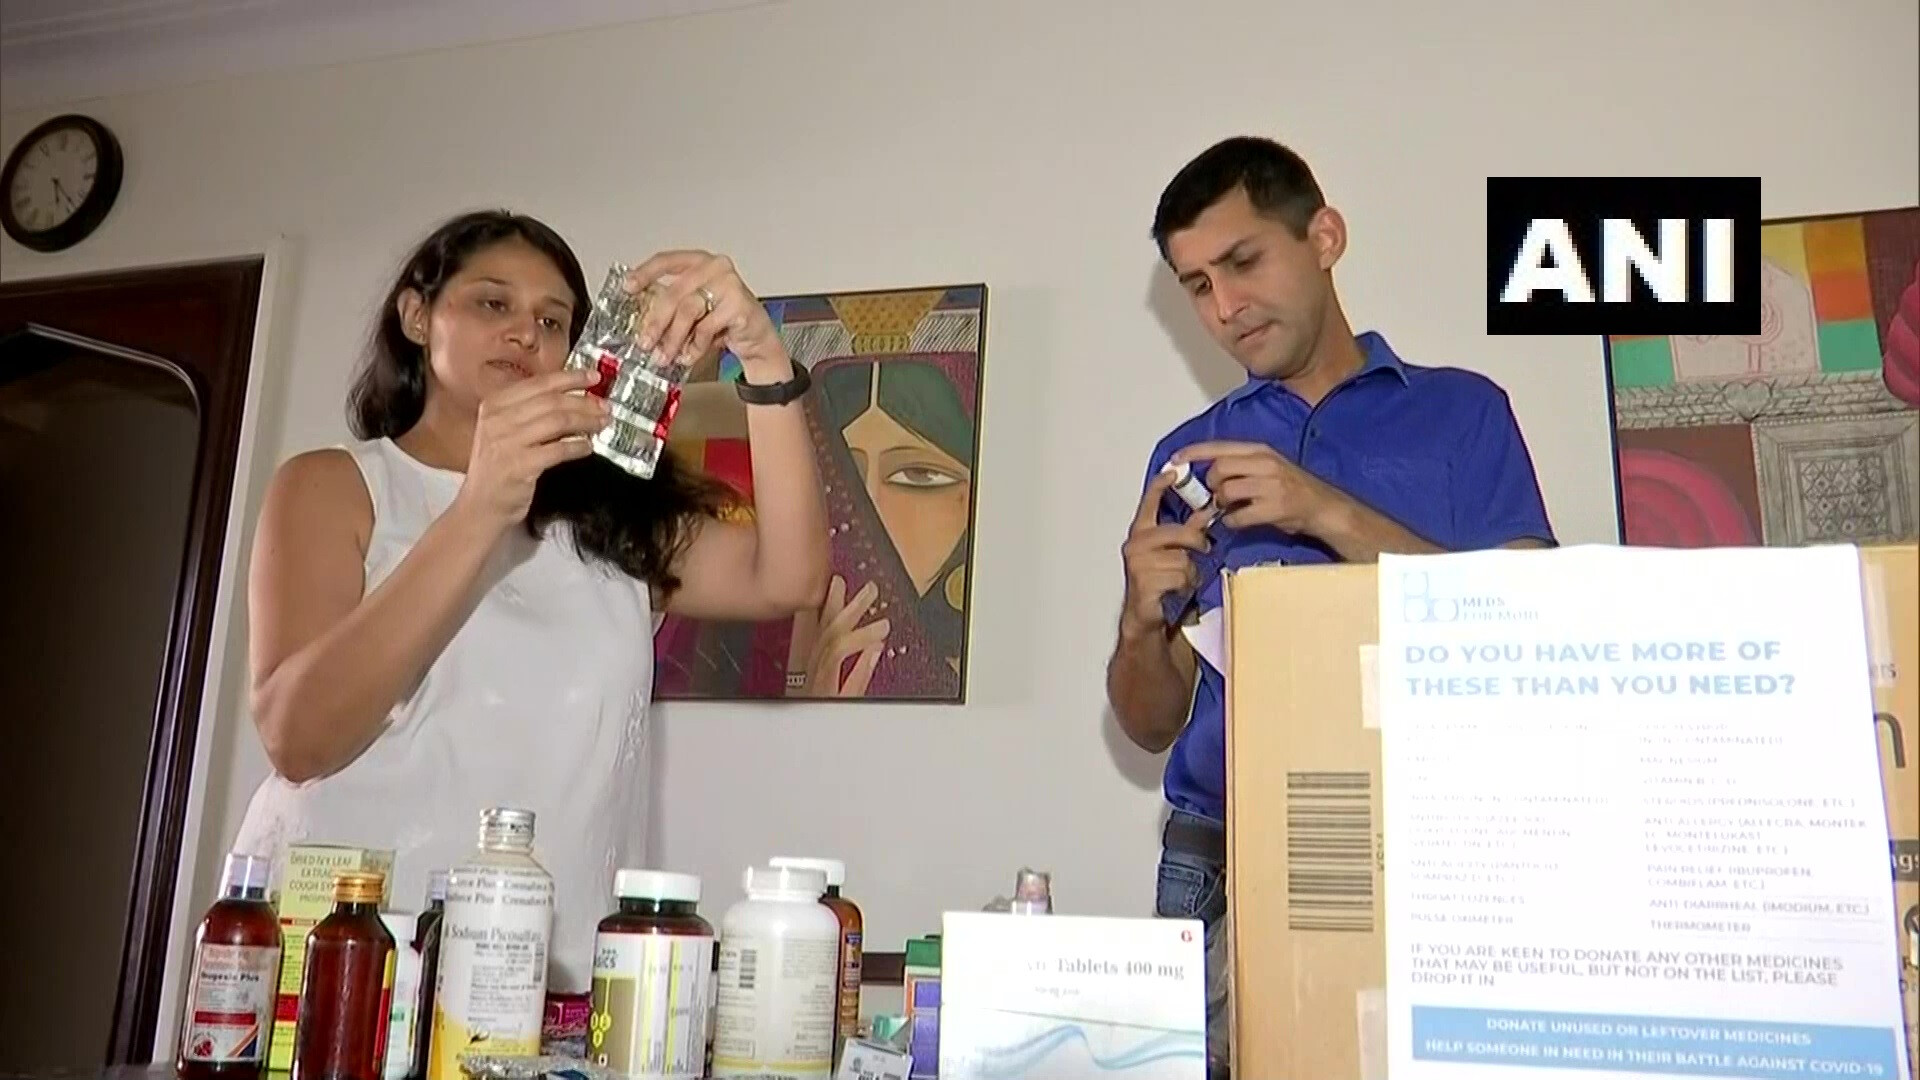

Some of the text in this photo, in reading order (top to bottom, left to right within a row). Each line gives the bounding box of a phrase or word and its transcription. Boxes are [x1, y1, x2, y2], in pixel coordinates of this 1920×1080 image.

[1405, 640, 1781, 664] DO YOU HAVE MORE OF
[1407, 673, 1796, 696] THESE THAN YOU NEED?
[1058, 957, 1119, 976] Tablets
[1125, 960, 1152, 976] 400
[1157, 964, 1185, 981] mg
[1411, 943, 1844, 972] IF YOU ARE KEEN TO DONATE ANY OTHER MEDICINES
[1411, 957, 1450, 970] THAT
[1455, 958, 1488, 971] MAY
[1492, 960, 1513, 973] BE
[1588, 963, 1621, 977] BUT
[1624, 965, 1660, 979] NOT
[1663, 966, 1689, 981] ON
[1694, 967, 1727, 982] THE
[1772, 970, 1839, 986] PLEASE
[1411, 971, 1496, 987] DROP IT IN
[1486, 1017, 1812, 1046] DONATE UNUSED OR LEFTOVER MEDICINES
[1425, 1038, 1884, 1076] HELP SOMEONE IN NEED IN THEIR BATTLE AGAINST COVID-19
